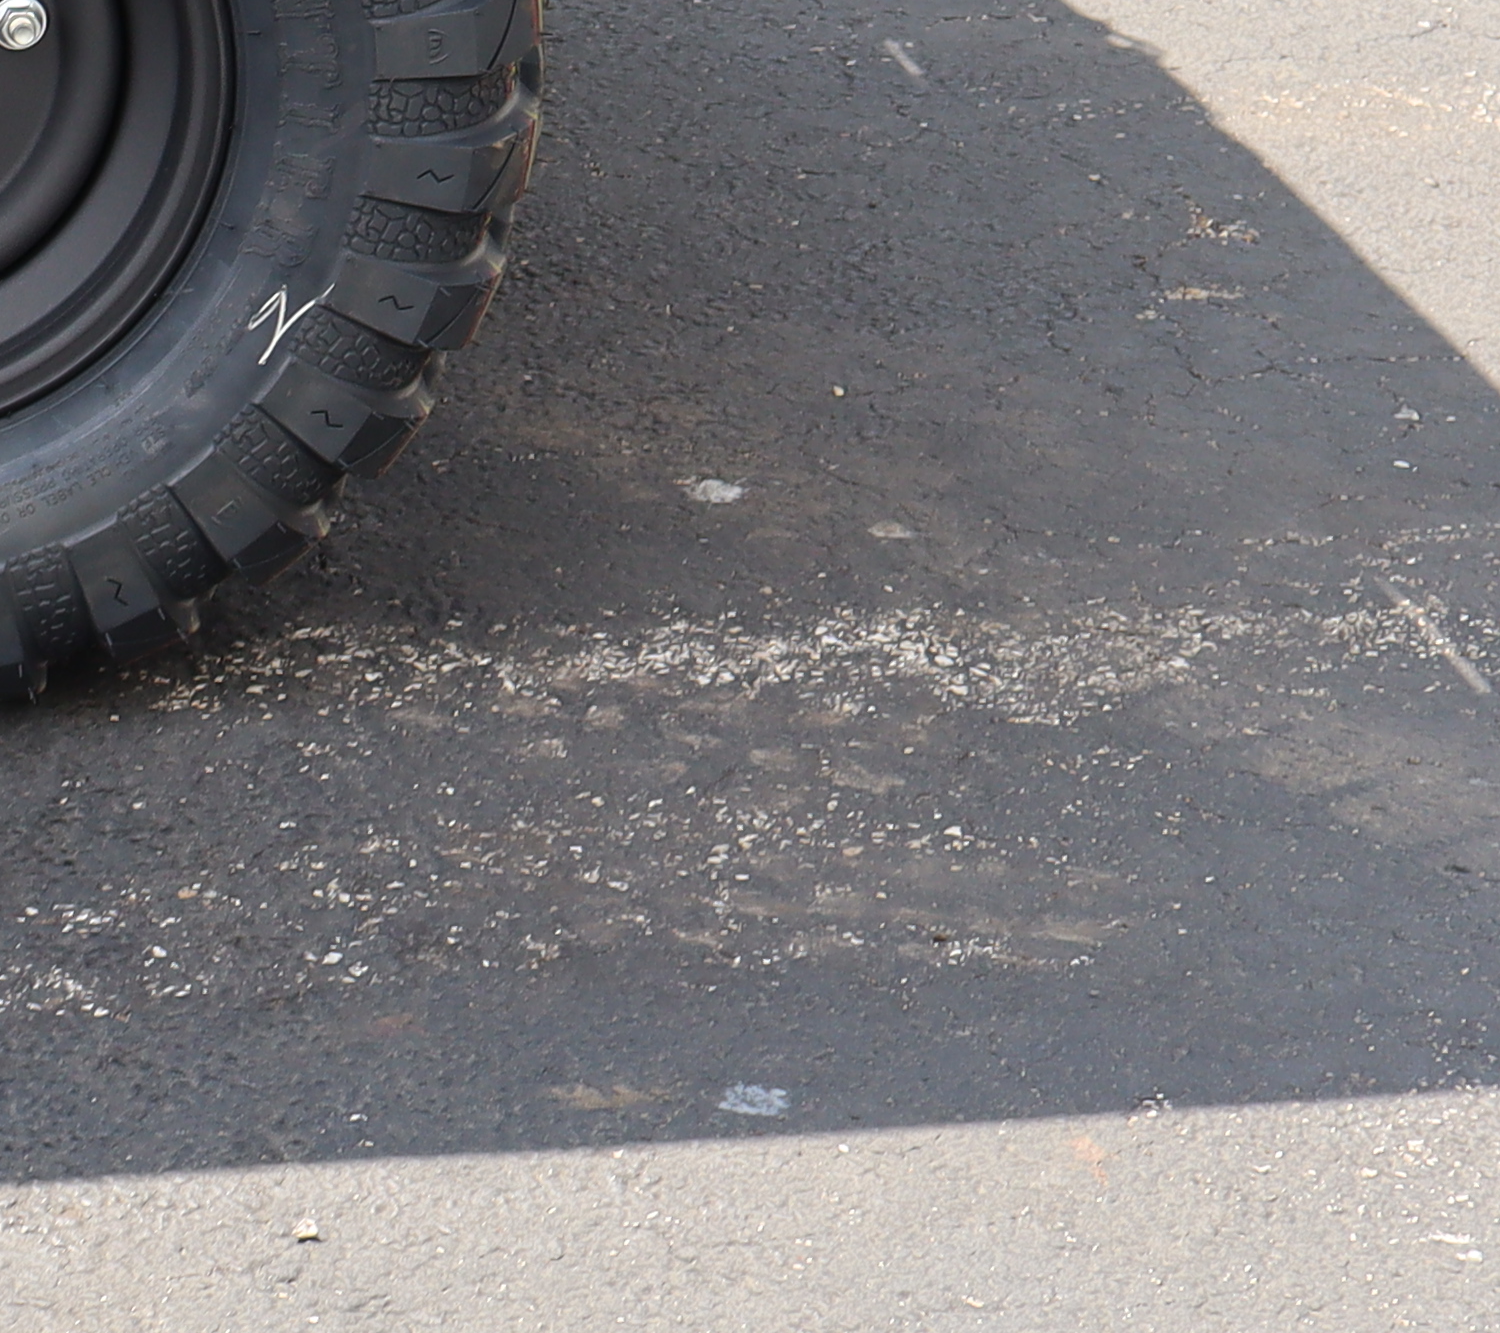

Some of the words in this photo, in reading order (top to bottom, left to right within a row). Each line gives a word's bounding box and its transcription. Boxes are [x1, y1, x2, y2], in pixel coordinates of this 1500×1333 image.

[85, 447, 139, 487] VEHCLE
[40, 480, 83, 509] LABEL
[16, 501, 37, 519] OR
